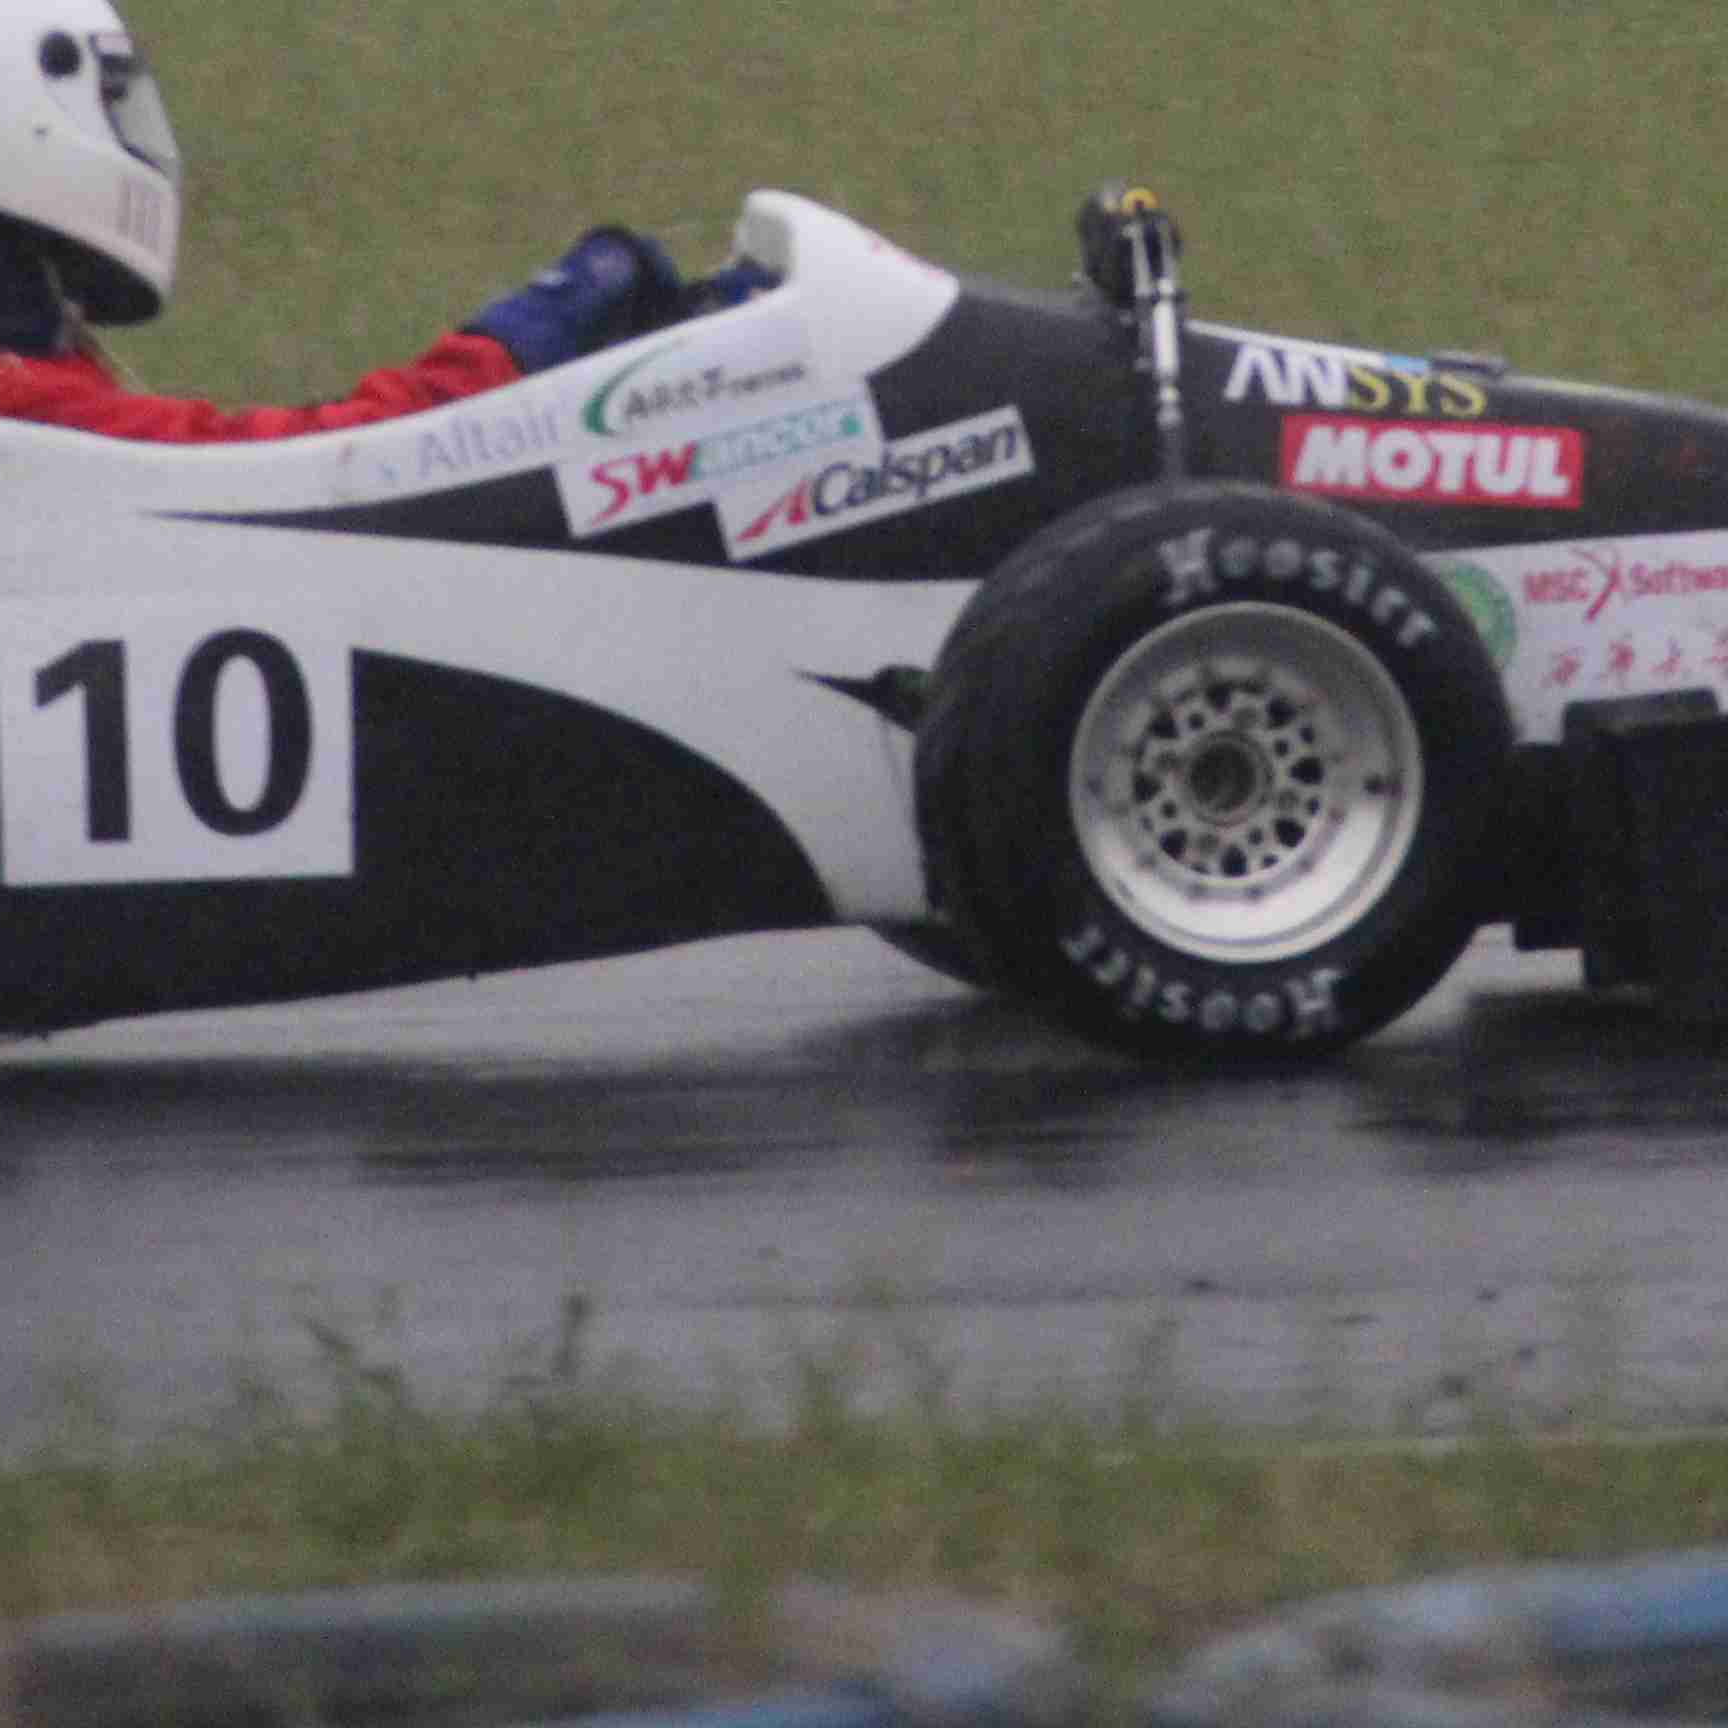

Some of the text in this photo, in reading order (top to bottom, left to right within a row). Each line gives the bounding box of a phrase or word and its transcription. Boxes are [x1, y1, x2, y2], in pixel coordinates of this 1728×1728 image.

[1223, 343, 1488, 417] ANSYS
[415, 400, 562, 478] Altair
[812, 419, 1020, 519] Calspan
[1295, 424, 1571, 498] MOTUL
[33, 626, 313, 843] 10
